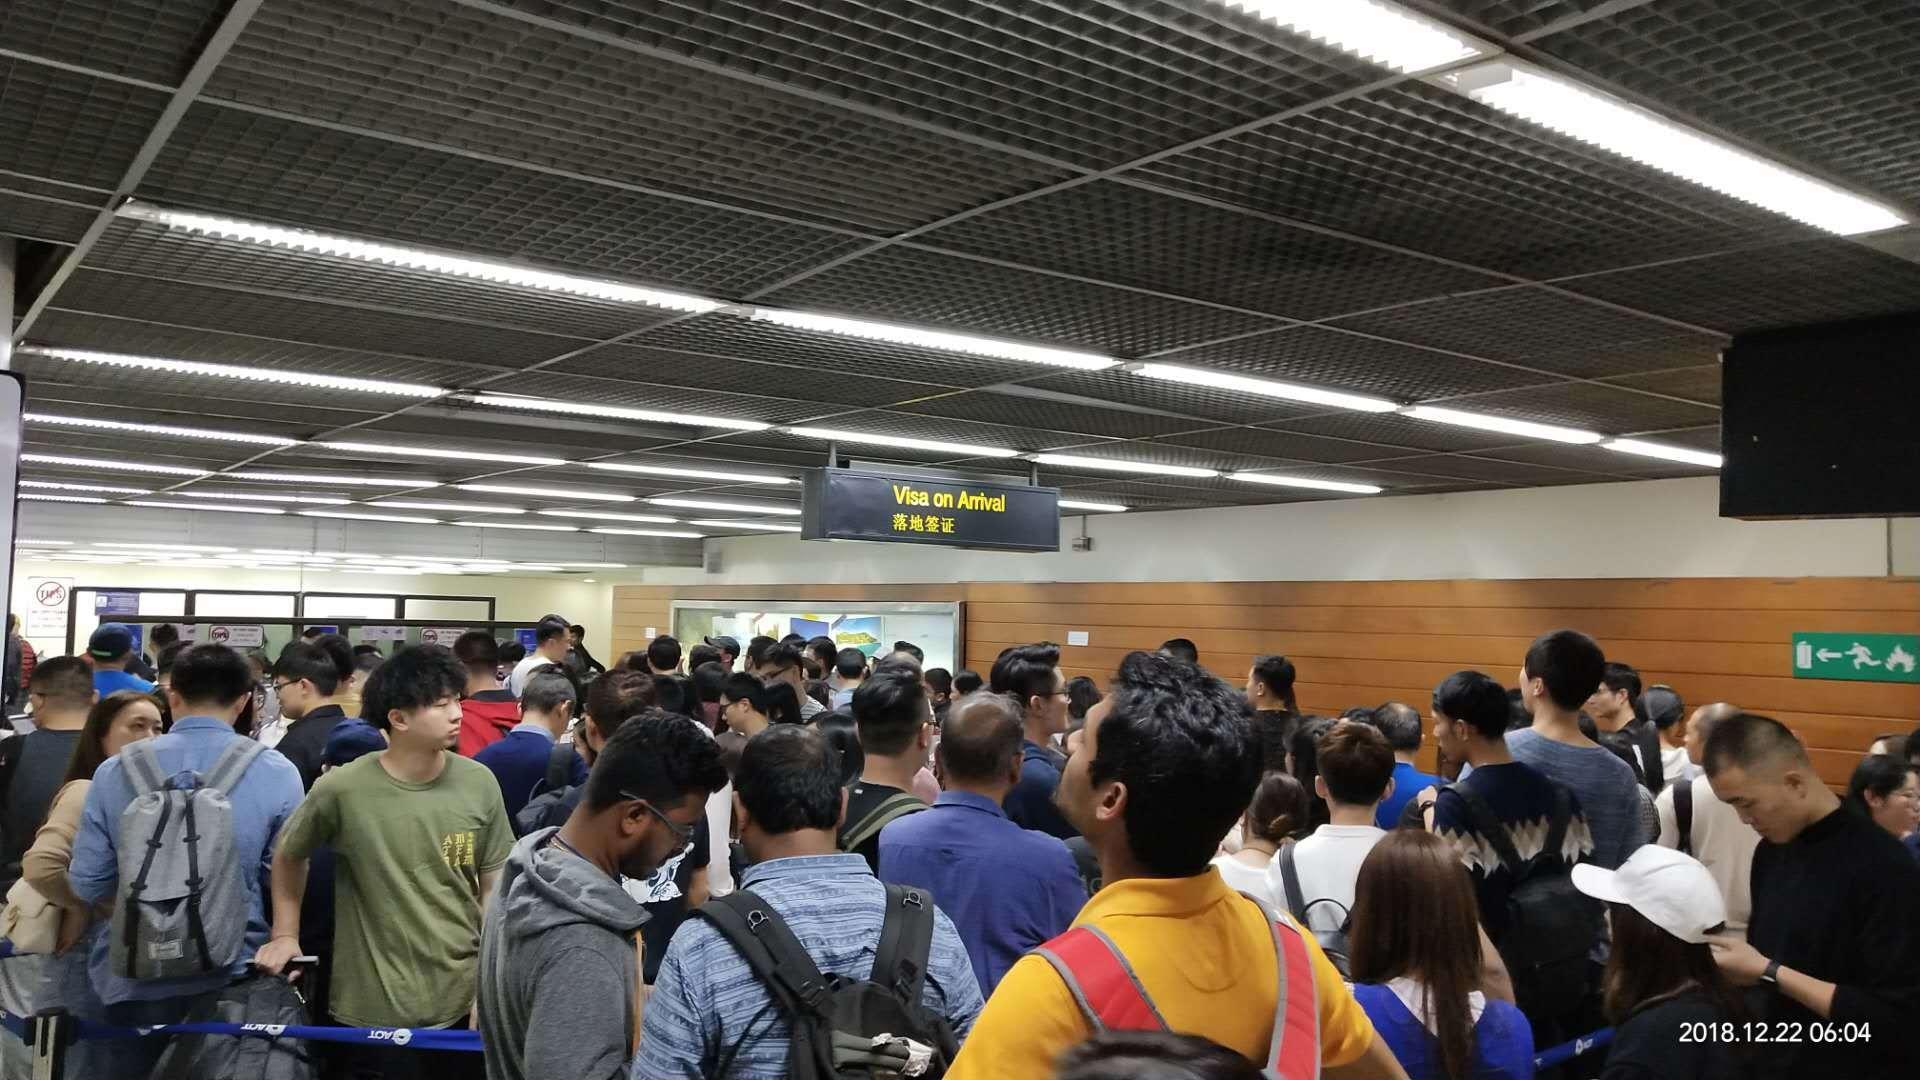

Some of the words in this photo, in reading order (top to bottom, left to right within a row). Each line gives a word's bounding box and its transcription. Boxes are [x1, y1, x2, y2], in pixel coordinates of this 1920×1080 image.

[893, 484, 929, 506] Visa
[933, 492, 953, 508] on
[957, 490, 1005, 512] Arrival
[892, 513, 955, 533] 落地签证
[368, 1030, 393, 1040] AOT
